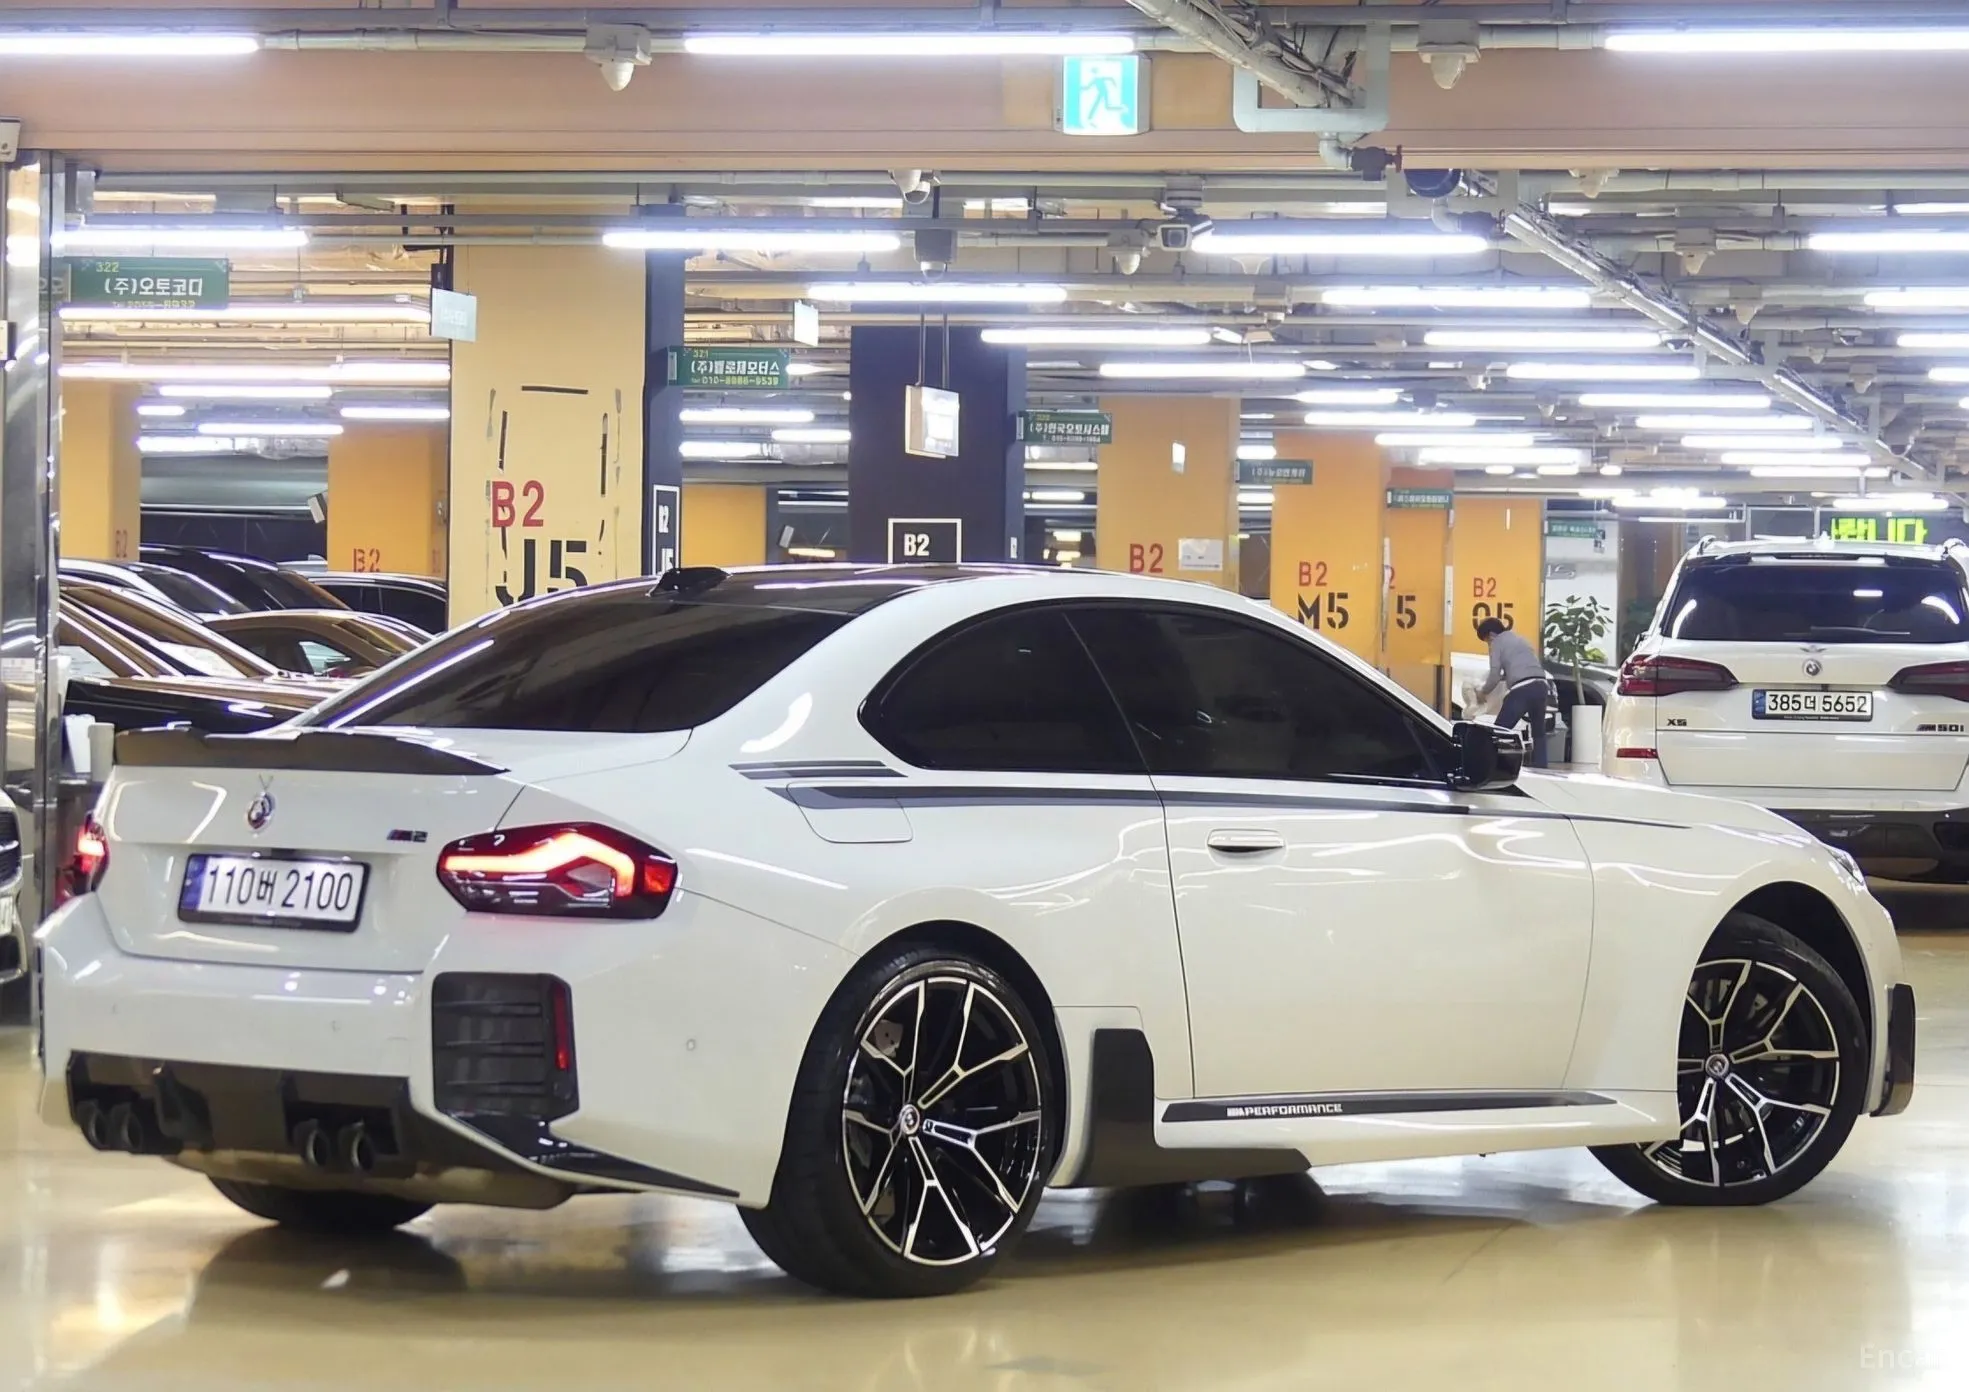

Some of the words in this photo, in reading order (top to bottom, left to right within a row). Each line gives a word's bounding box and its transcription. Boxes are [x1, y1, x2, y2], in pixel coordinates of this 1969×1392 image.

[95, 261, 120, 273] 322
[104, 277, 203, 297] (주)오토코디
[491, 480, 545, 528] B2
[904, 533, 930, 557] B2
[353, 548, 381, 573] B2
[1129, 543, 1164, 573] B2
[495, 539, 588, 607] J5
[1299, 561, 1328, 587] B2
[1473, 577, 1496, 598] B2
[1297, 592, 1350, 630] M5
[1768, 694, 1817, 711] 385더
[1821, 695, 1868, 713] 5652
[208, 866, 278, 905] 110버
[281, 868, 353, 911] 2100
